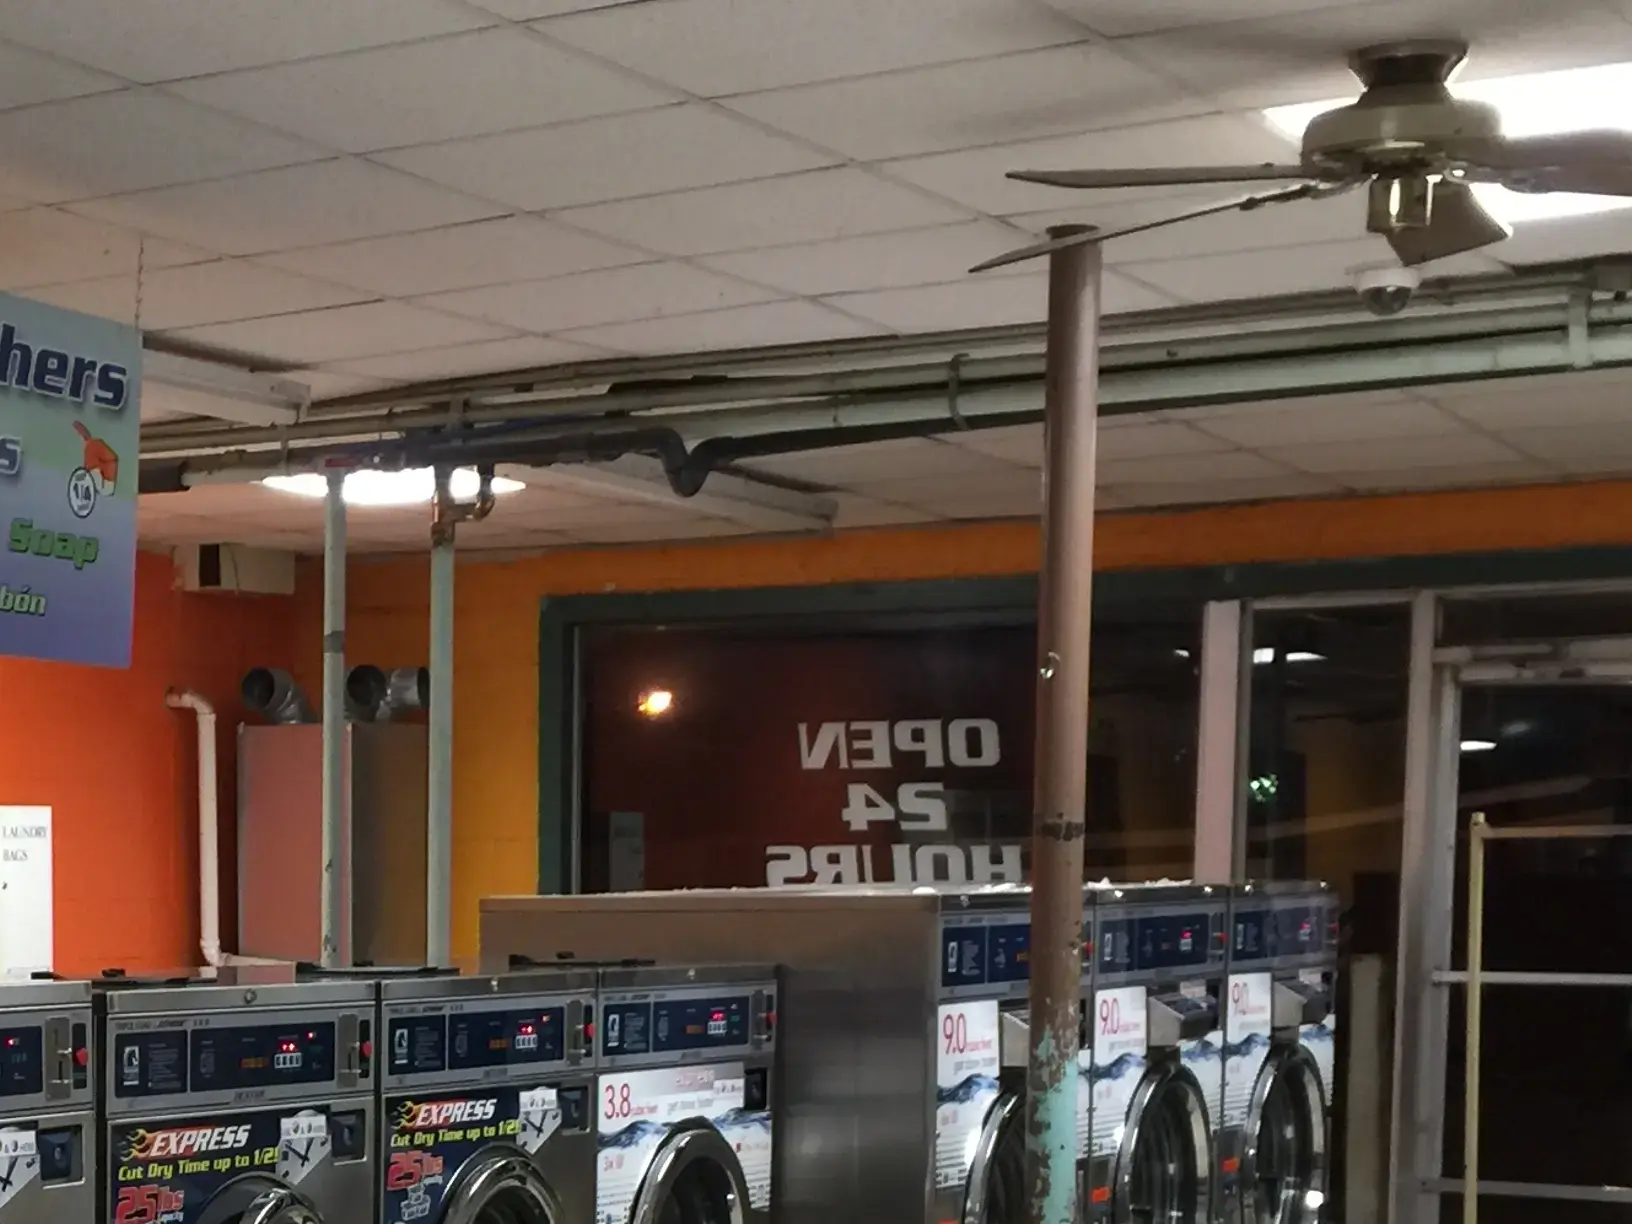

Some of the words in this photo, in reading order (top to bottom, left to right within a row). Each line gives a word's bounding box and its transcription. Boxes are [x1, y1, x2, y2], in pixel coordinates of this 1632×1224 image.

[8, 518, 101, 570] Soap
[2, 825, 48, 839] LAUNDRY
[2, 848, 29, 862] BAGS
[1099, 998, 1120, 1036] 9.0
[943, 1012, 967, 1055] 9.0
[415, 1098, 499, 1127] EXPRESS
[603, 1082, 632, 1120] 3.8
[148, 1123, 253, 1158] EXPRESS
[389, 1132, 410, 1148] Cut
[413, 1131, 436, 1148] Dry
[437, 1127, 465, 1143] Time
[466, 1127, 483, 1141] up
[483, 1125, 497, 1138] to
[118, 1164, 144, 1181] Cut
[146, 1161, 174, 1180] Dry
[177, 1158, 210, 1174] Time
[212, 1156, 232, 1172] up
[234, 1153, 251, 1168] to
